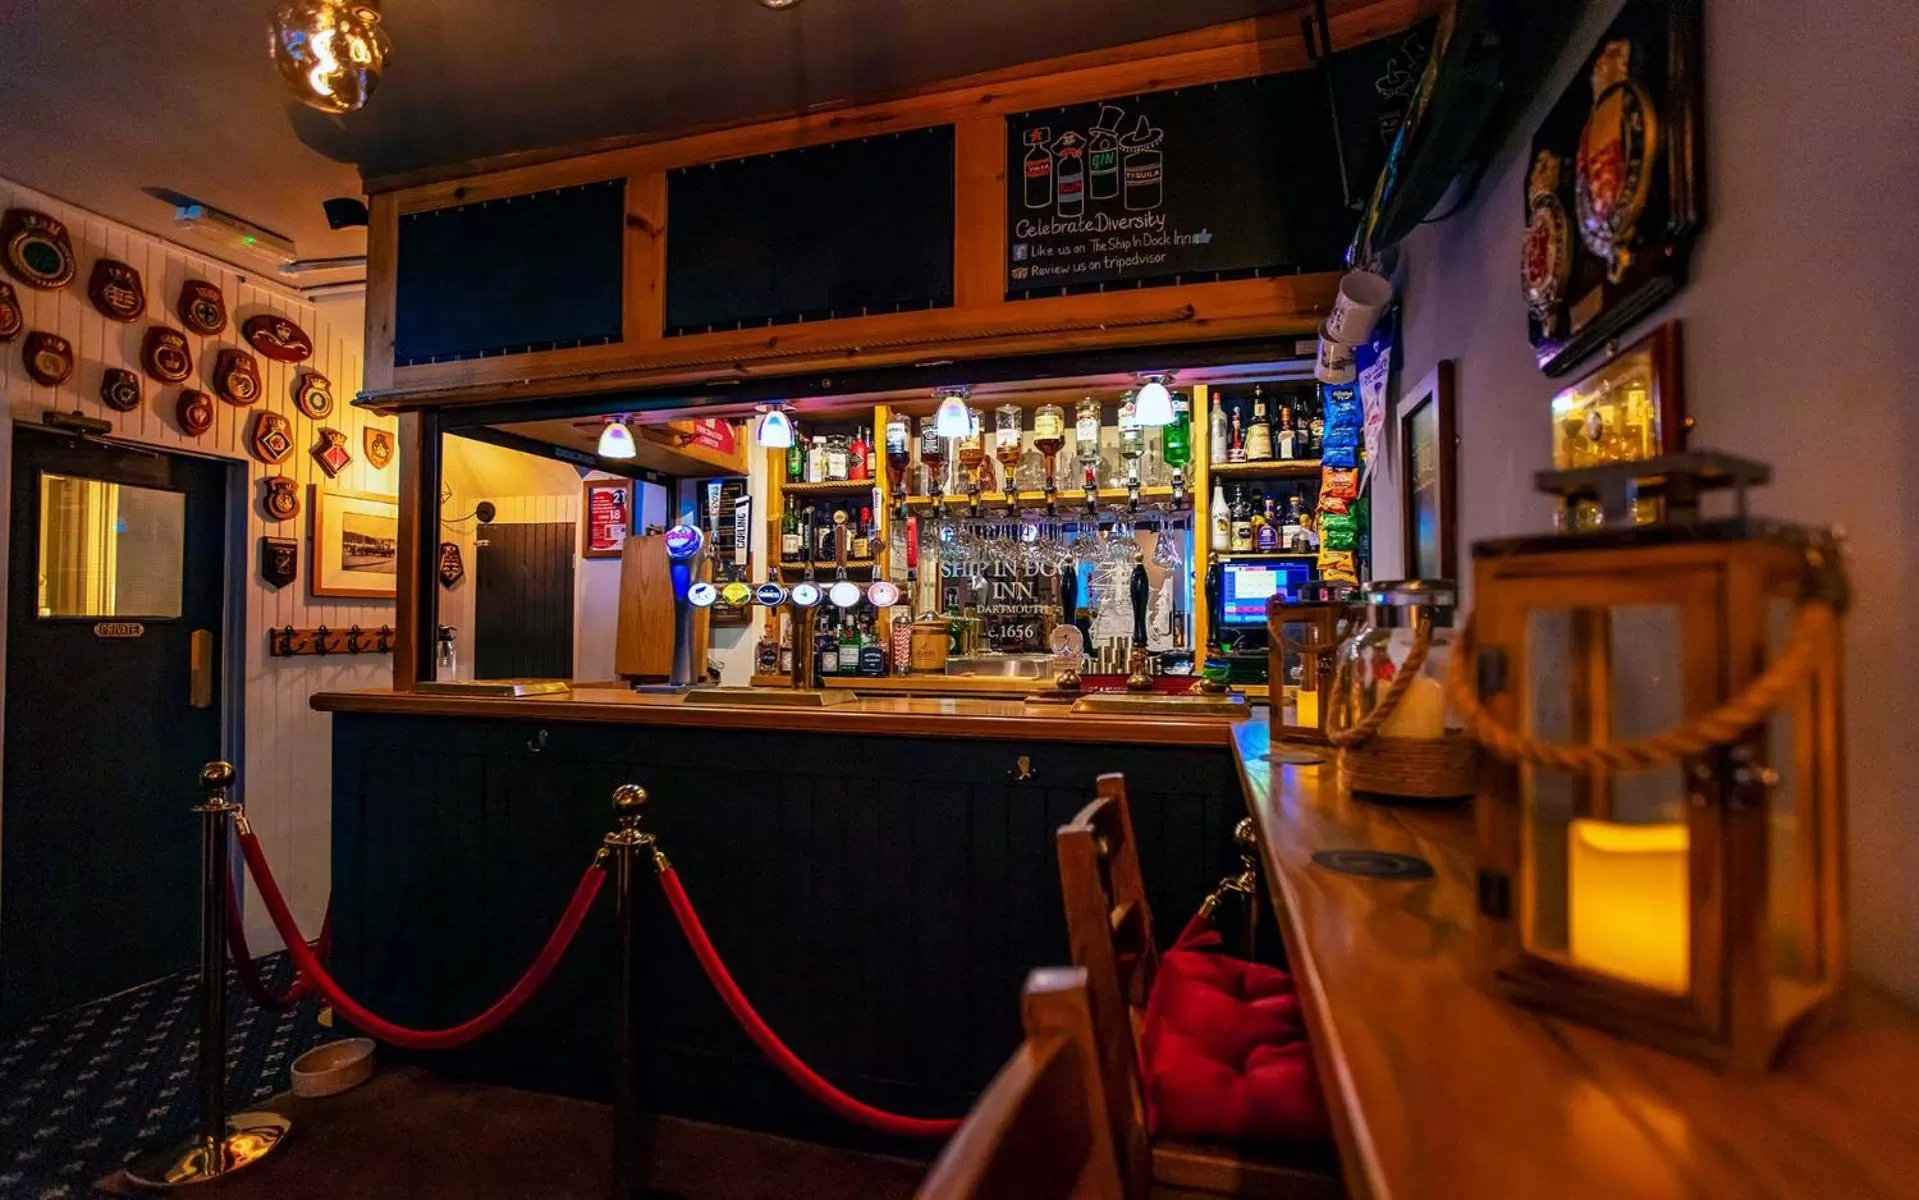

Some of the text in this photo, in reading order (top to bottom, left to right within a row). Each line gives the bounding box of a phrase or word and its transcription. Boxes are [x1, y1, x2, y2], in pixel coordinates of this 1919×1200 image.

[1092, 152, 1114, 170] GIN
[1015, 211, 1166, 238] Celebrate Diversity
[1031, 245, 1053, 257] Like
[1057, 246, 1071, 256] us
[1074, 245, 1086, 254] on
[1090, 238, 1107, 253] The
[1108, 236, 1131, 253] Ship
[1132, 235, 1142, 248] In
[1143, 231, 1171, 247] Dock
[1173, 229, 1192, 245] Inn
[1031, 251, 1167, 277] Review us on tripadvisor
[610, 510, 621, 521] 18
[736, 512, 746, 549] CARLING
[941, 560, 990, 578] SHIP
[993, 560, 1018, 578] IN
[992, 582, 1034, 599] INN
[101, 623, 140, 635] PRIVATE
[988, 624, 1034, 638] c.1656
